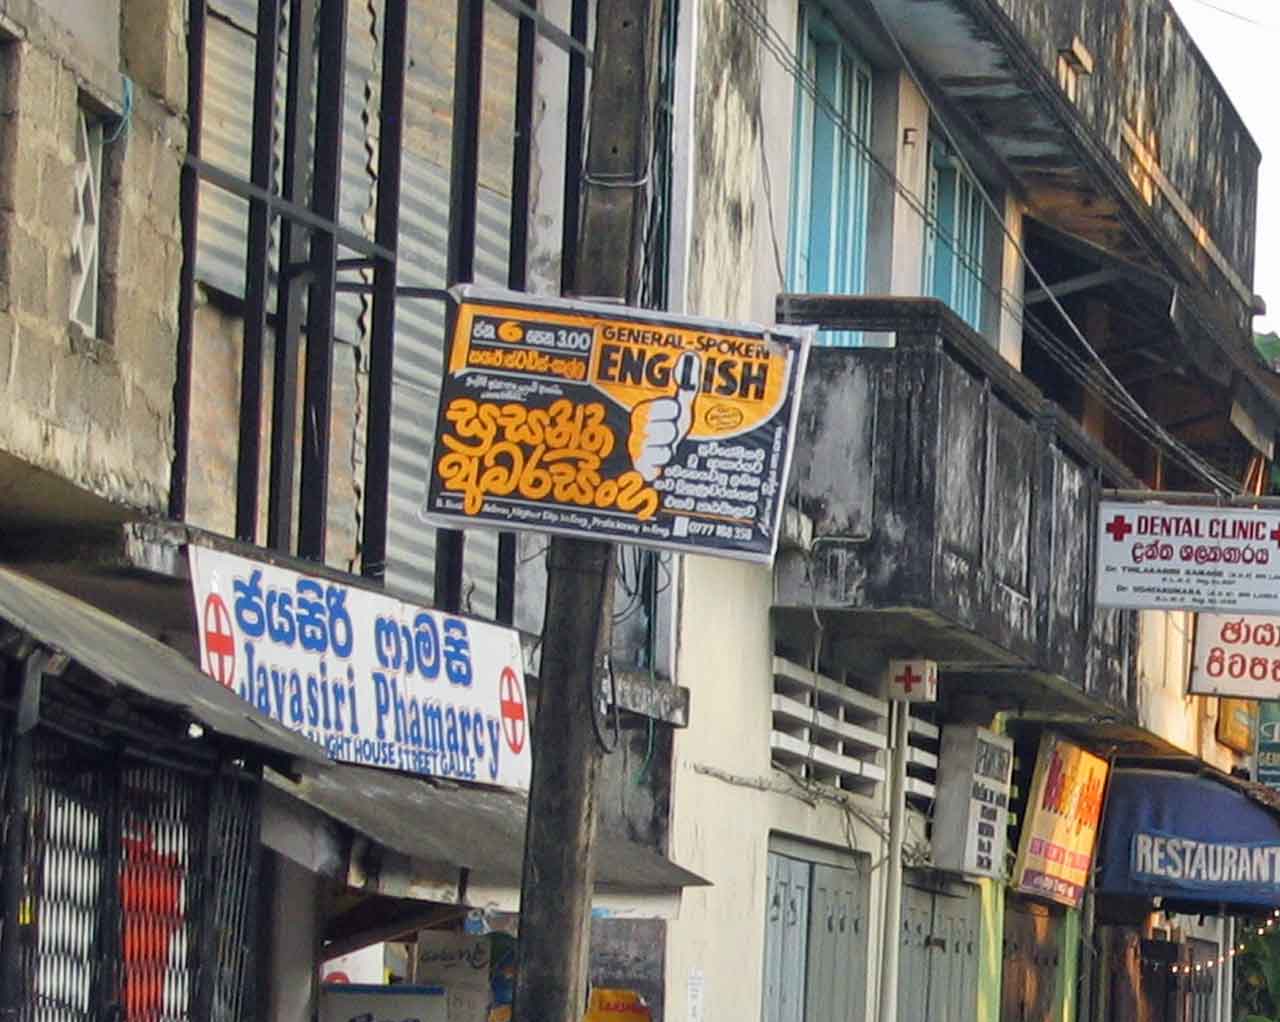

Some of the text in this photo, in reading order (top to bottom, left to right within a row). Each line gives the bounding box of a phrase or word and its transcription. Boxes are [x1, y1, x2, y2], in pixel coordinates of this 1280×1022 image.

[497, 320, 524, 342] 6
[556, 329, 591, 350] 3.00
[597, 344, 769, 400] ENGLISH
[1137, 515, 1267, 540] DENTAL CLINIC
[371, 671, 500, 780] Phamarcy
[318, 734, 351, 760] IGHT
[355, 740, 396, 766] HOUSE
[399, 744, 438, 776] STREET
[440, 752, 477, 780] GALLE
